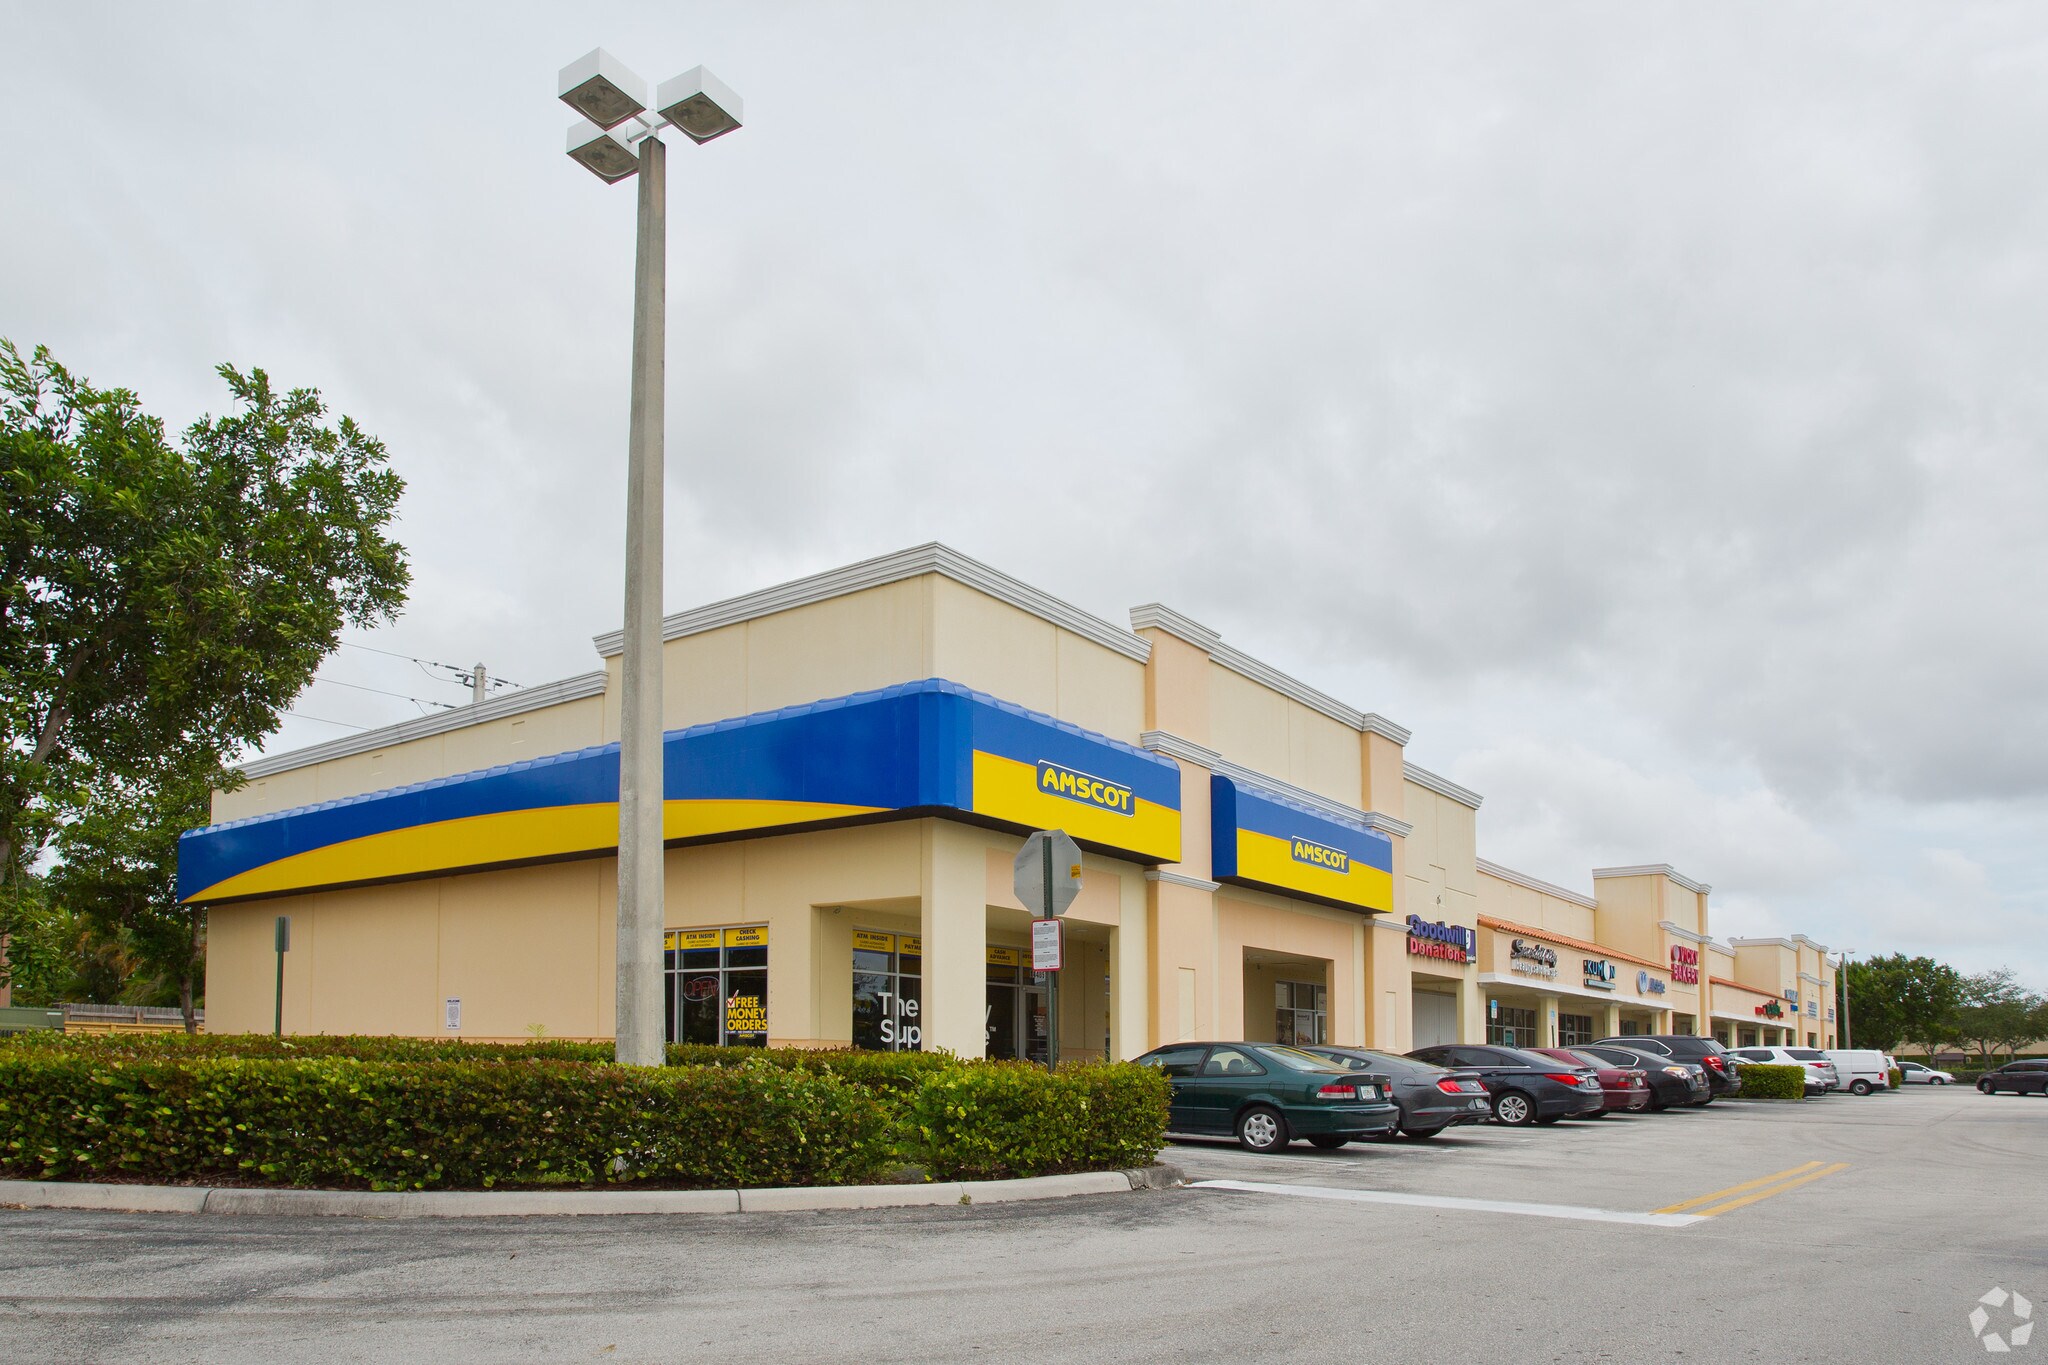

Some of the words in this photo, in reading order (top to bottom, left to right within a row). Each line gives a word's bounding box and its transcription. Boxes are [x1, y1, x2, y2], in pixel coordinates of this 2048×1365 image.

[1042, 768, 1131, 811] AMSCOT
[1294, 841, 1347, 870] AMSCOT
[869, 934, 889, 942] INSIDE
[1407, 914, 1466, 946] Goodwill
[1409, 937, 1467, 963] Donations
[1679, 945, 1699, 966] VICKY
[1590, 960, 1616, 982] KUMON
[1672, 963, 1699, 985] BAKERY
[685, 980, 718, 997] OPEN
[727, 1007, 767, 1019] MONEY
[735, 996, 759, 1008] FREE
[877, 991, 919, 1017] The
[727, 1019, 769, 1031] ORDERS
